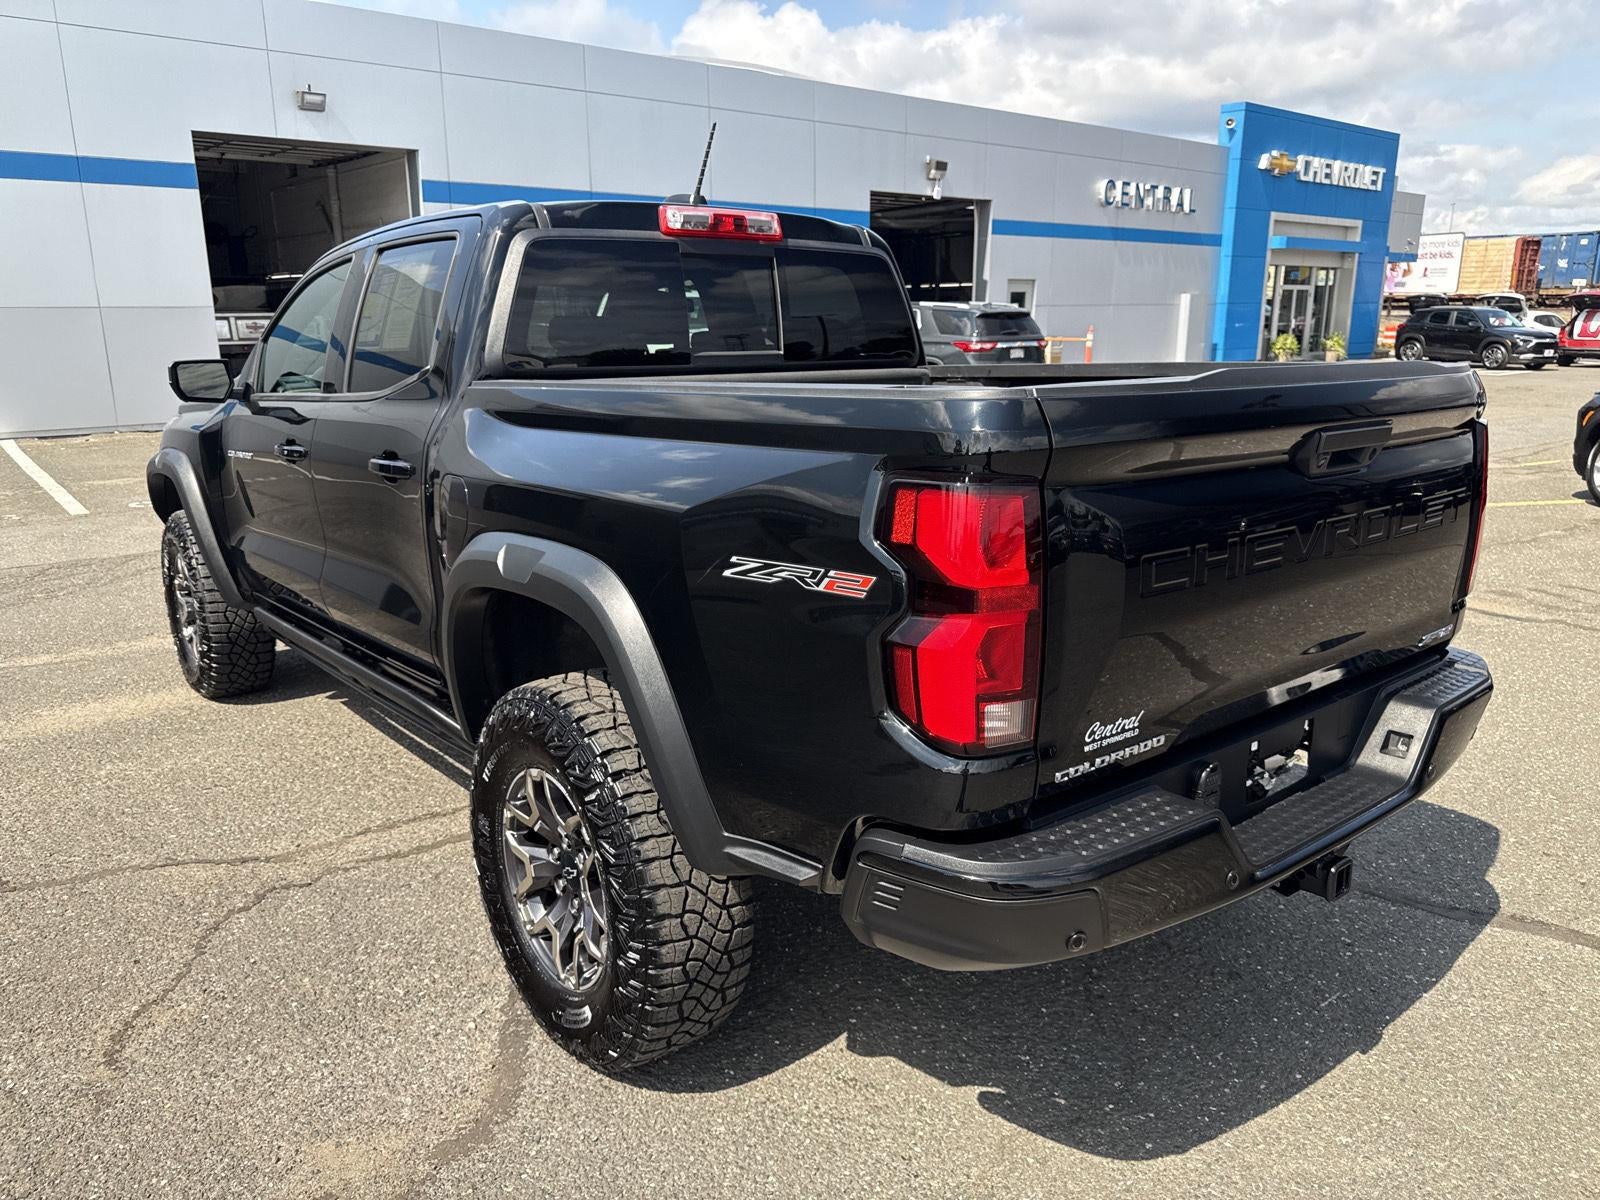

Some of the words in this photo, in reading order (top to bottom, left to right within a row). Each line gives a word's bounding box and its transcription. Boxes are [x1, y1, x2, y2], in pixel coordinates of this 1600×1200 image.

[1296, 154, 1386, 192] CHEVROLET
[1099, 178, 1196, 214] CENTRAL
[1140, 486, 1469, 598] CHEVROLET
[722, 556, 877, 599] ZR2
[1083, 740, 1101, 753] WEST
[1101, 728, 1140, 747] SPRINGFIELD
[1084, 709, 1145, 743] Central
[1054, 734, 1166, 784] COLORADO
